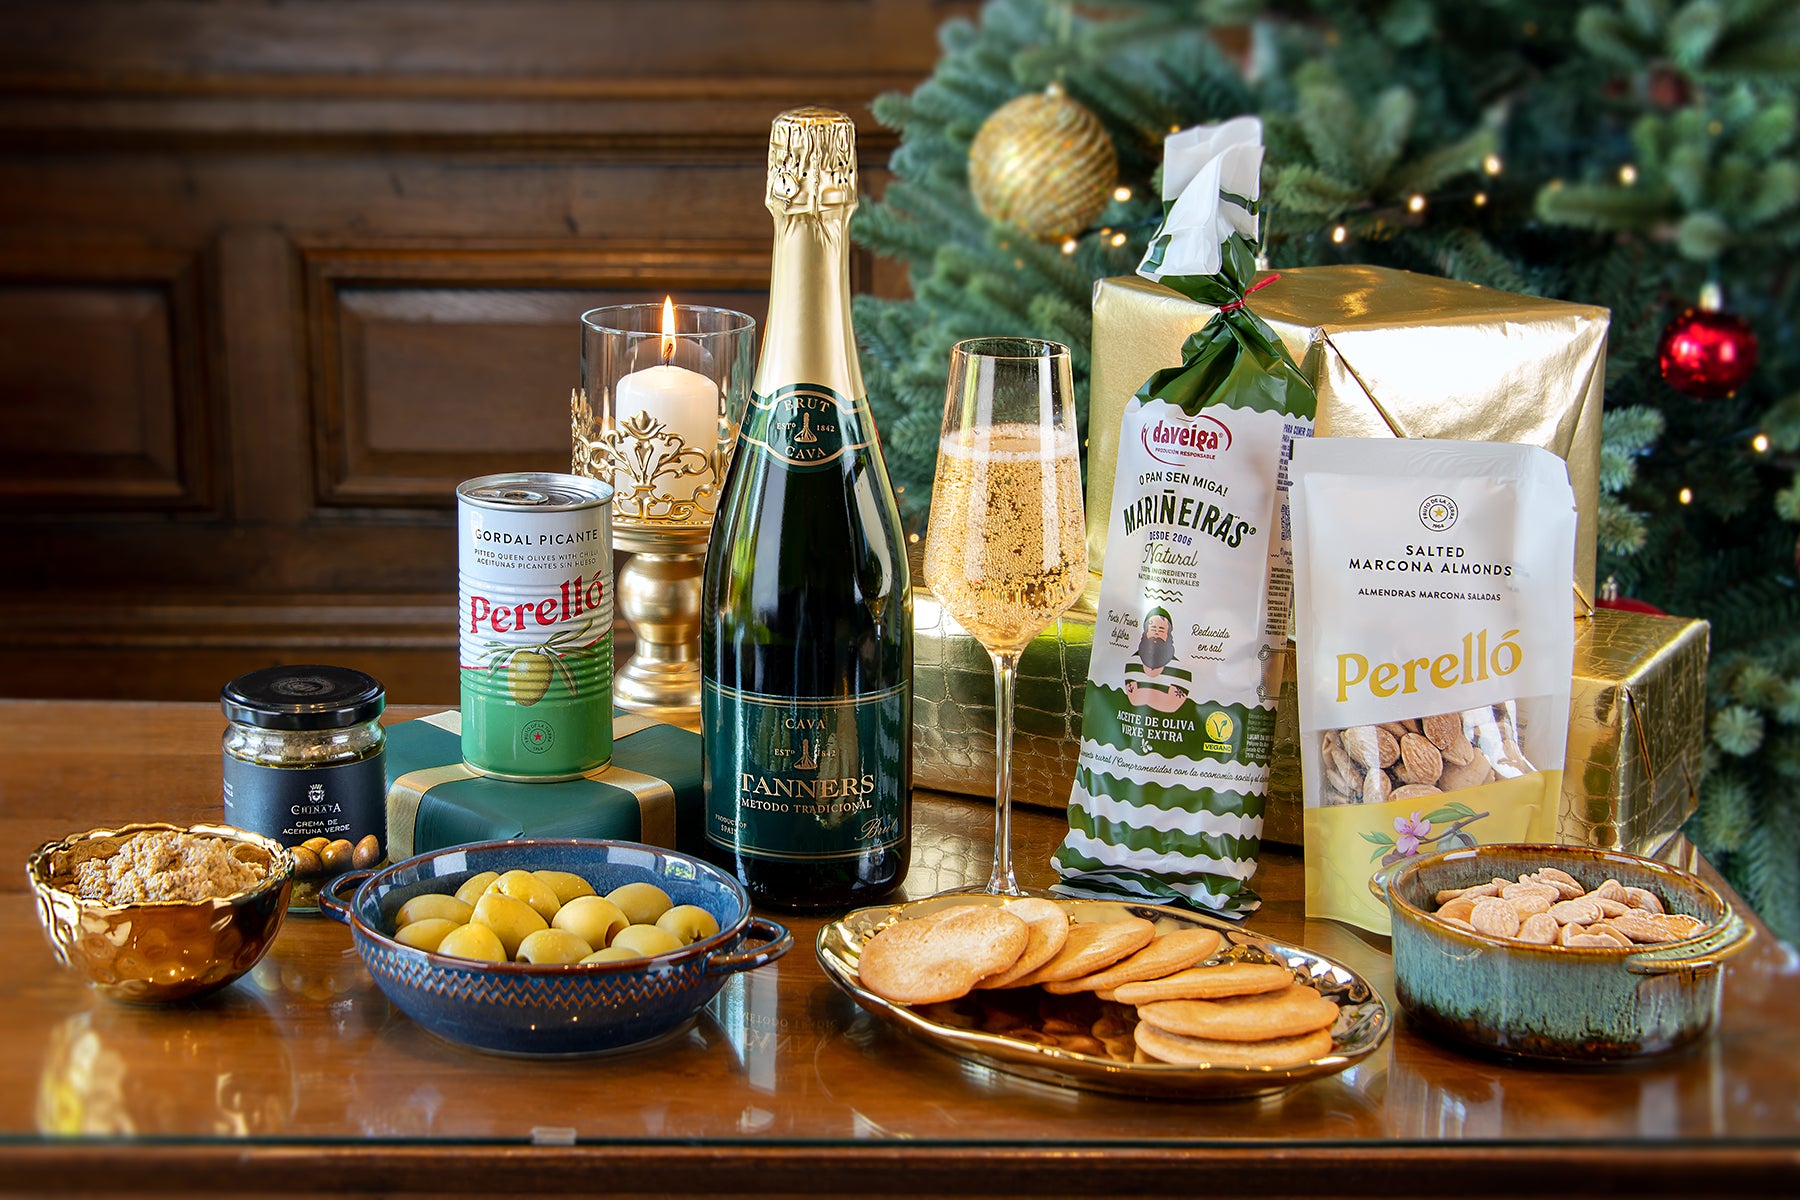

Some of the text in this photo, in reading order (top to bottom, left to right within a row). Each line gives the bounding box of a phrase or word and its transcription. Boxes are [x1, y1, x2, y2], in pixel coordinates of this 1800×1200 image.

[784, 397, 830, 413] BRUT
[816, 425, 835, 433] 1842
[1152, 420, 1219, 452] daveiga
[784, 446, 827, 460] CAVA
[1180, 451, 1216, 460] RESPONSABLE
[1139, 472, 1229, 497] O PAN SEN MIGA!
[1123, 489, 1252, 549] MARIÑEIRAS
[475, 528, 598, 546] GORDAL PICANTE
[1149, 531, 1193, 546] DESDE 2006
[474, 548, 496, 559] PITTED
[497, 552, 524, 562] QUEEN
[527, 554, 556, 562] OLIVES
[558, 553, 578, 561] WITH
[1142, 542, 1199, 567] Natural
[1405, 545, 1465, 558] SALTED
[476, 557, 516, 569] ACEITUNAS
[518, 562, 557, 570] PICANTES
[574, 558, 597, 568] HUESO
[1349, 558, 1512, 577] MARCONA ALMONDS
[1151, 568, 1198, 579] INGREDIENTES
[470, 570, 604, 634] Perelló
[1358, 588, 1502, 601] ALMENDRAS MARCONA SALADAS
[1191, 623, 1231, 639] Reducido
[1197, 642, 1223, 653] en sal
[1335, 628, 1523, 703] Perelló
[785, 718, 826, 731] CAVA
[1116, 710, 1195, 732] ACEITE DE OLIVA
[1121, 723, 1184, 743] VIRXE EXTRA
[1204, 743, 1232, 753] VEGANO
[740, 772, 876, 799] TANNERS
[290, 803, 341, 815] CHINATA
[741, 797, 873, 815] METODO TRADICIONAL
[282, 823, 351, 836] ACEITUNA VERDE
[295, 820, 325, 828] CREMA
[853, 817, 900, 842] Brut
